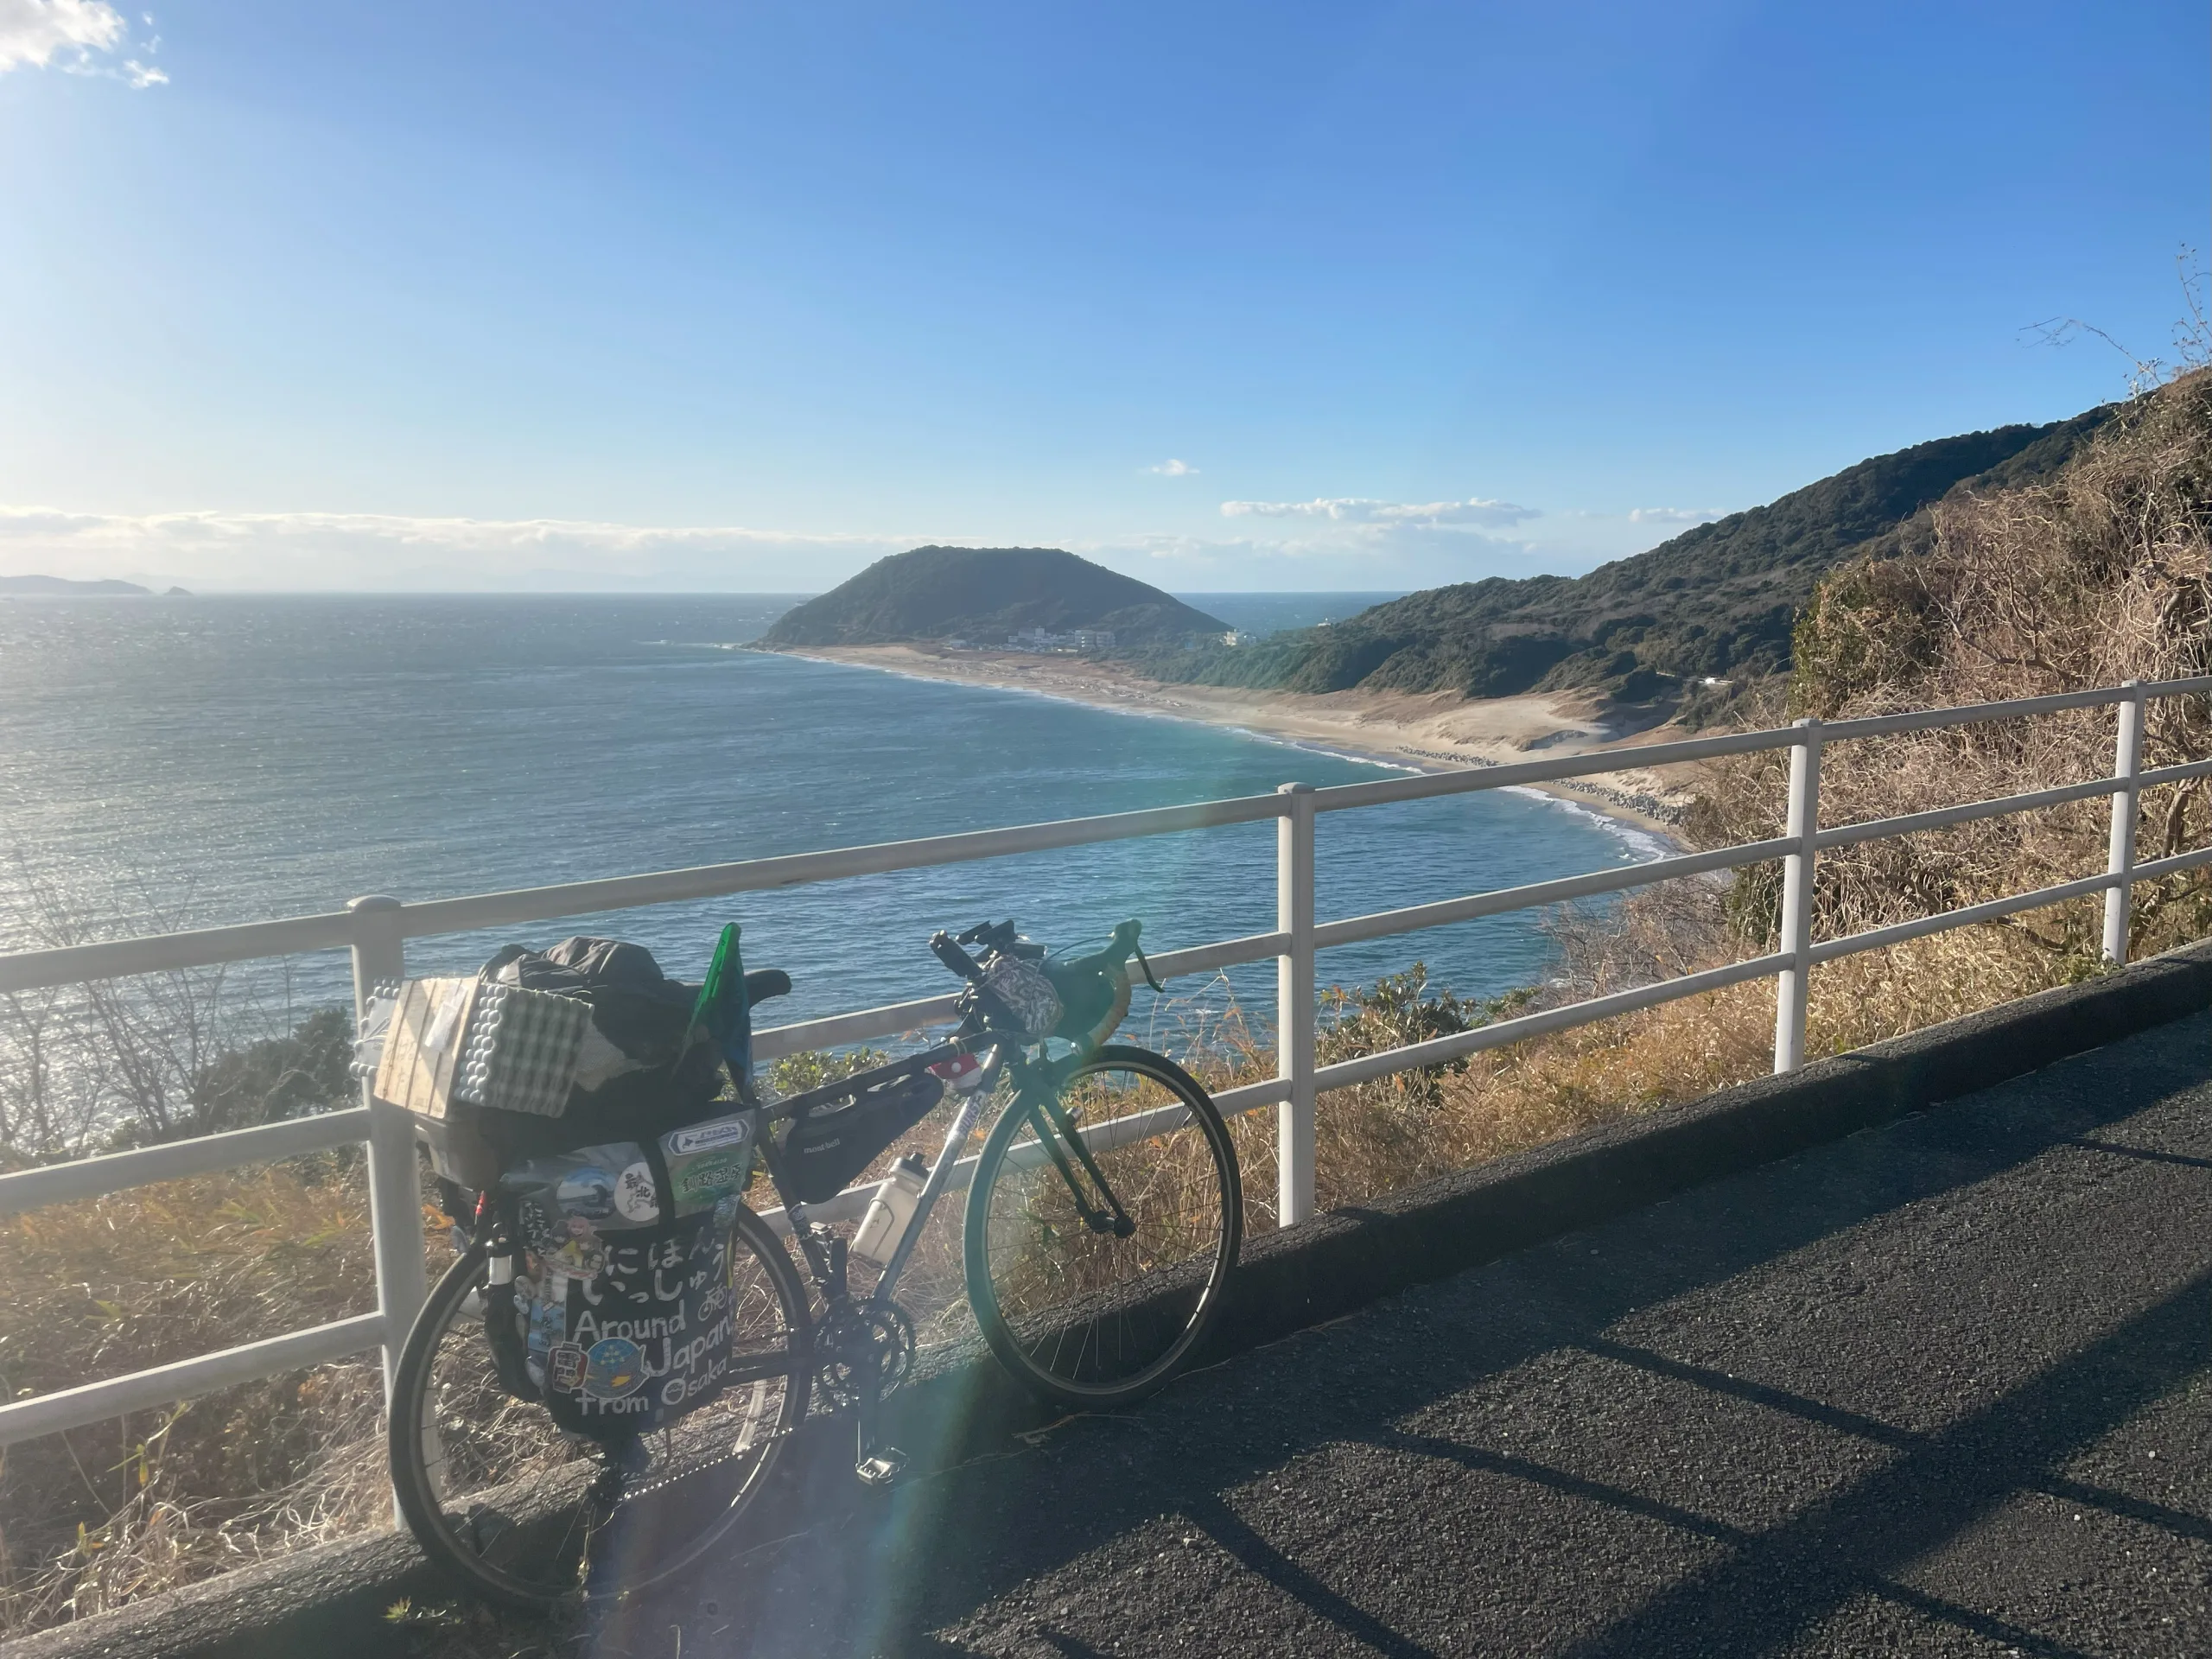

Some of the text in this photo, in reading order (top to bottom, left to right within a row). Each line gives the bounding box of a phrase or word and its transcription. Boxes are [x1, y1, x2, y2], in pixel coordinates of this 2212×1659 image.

[604, 1226, 715, 1276] にほん
[573, 1299, 686, 1343] Around
[645, 1315, 732, 1376] Japan
[575, 1356, 728, 1416] from Osaka
